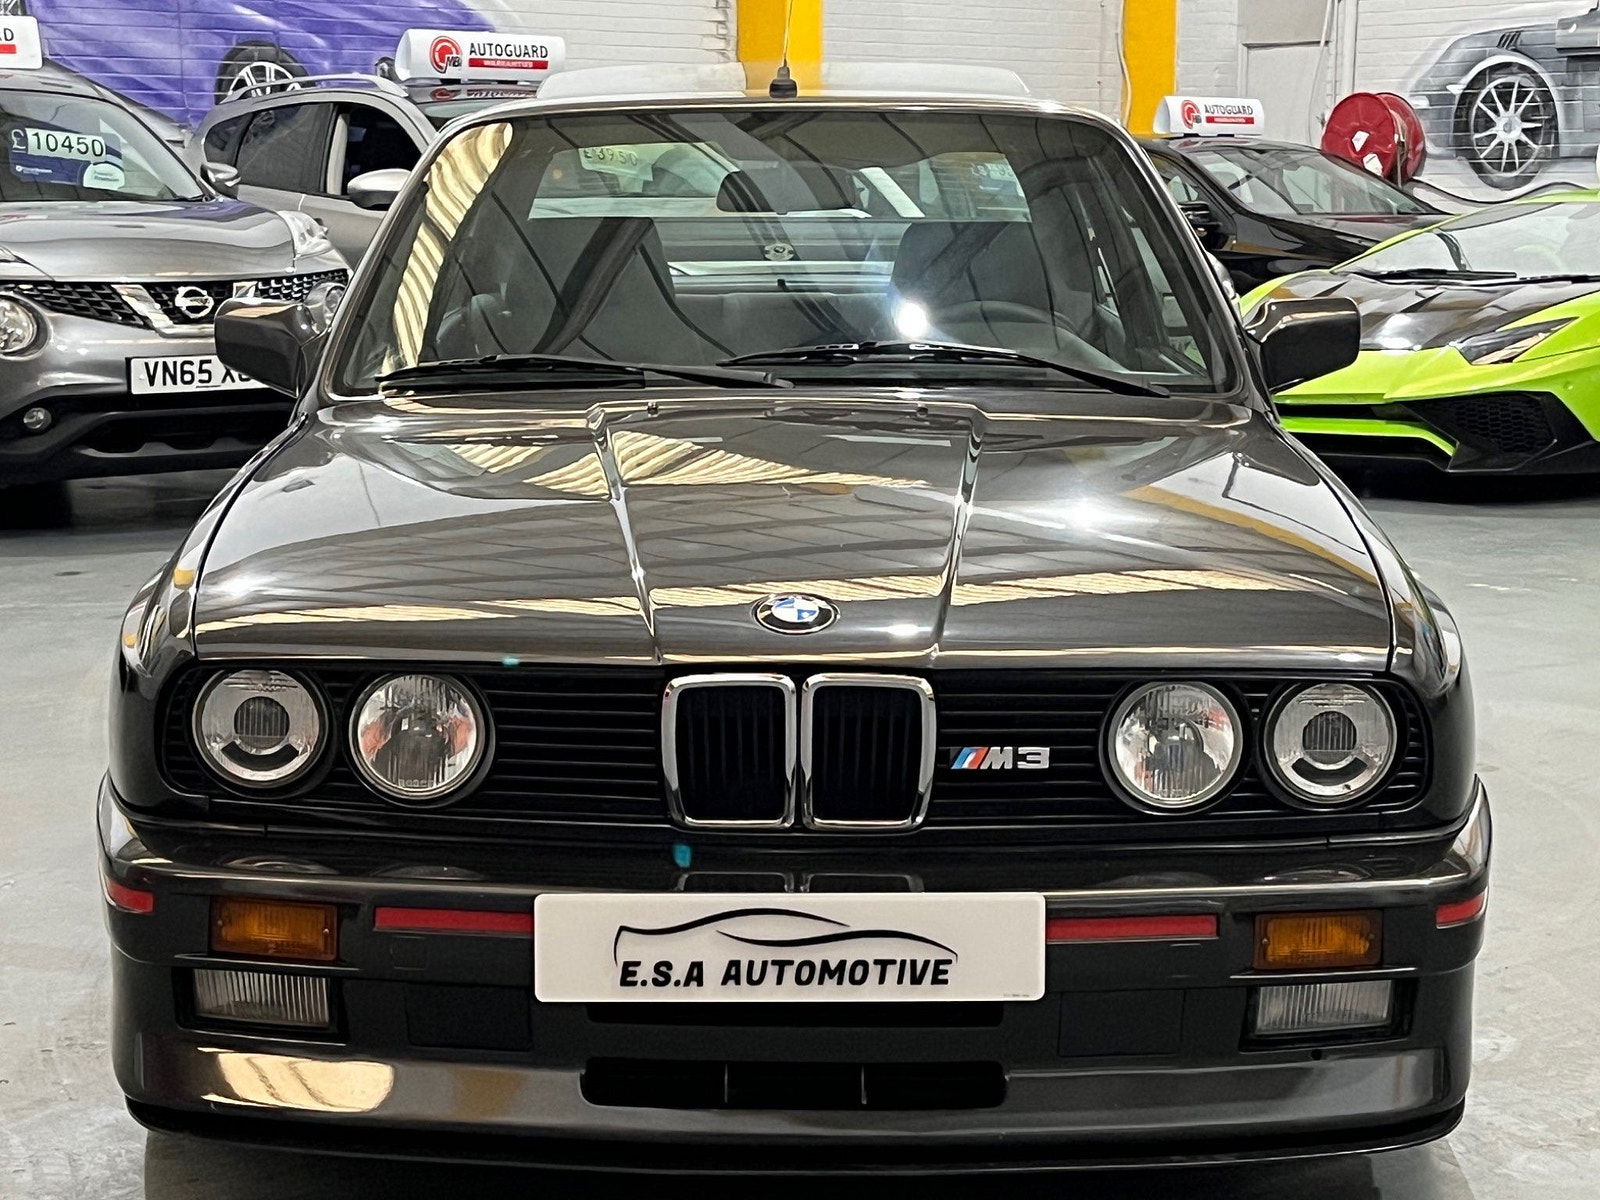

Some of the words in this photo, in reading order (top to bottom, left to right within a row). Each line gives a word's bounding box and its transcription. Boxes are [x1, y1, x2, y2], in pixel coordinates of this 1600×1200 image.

[469, 42, 549, 59] AUTOGUARD
[1204, 104, 1254, 116] AUTOGUARD
[11, 129, 104, 157] £10450
[144, 359, 213, 386] VN65
[221, 366, 253, 384] X
[979, 746, 1050, 770] M3
[619, 960, 705, 988] E.S.A
[720, 958, 954, 987] AUTOMOTIVE
